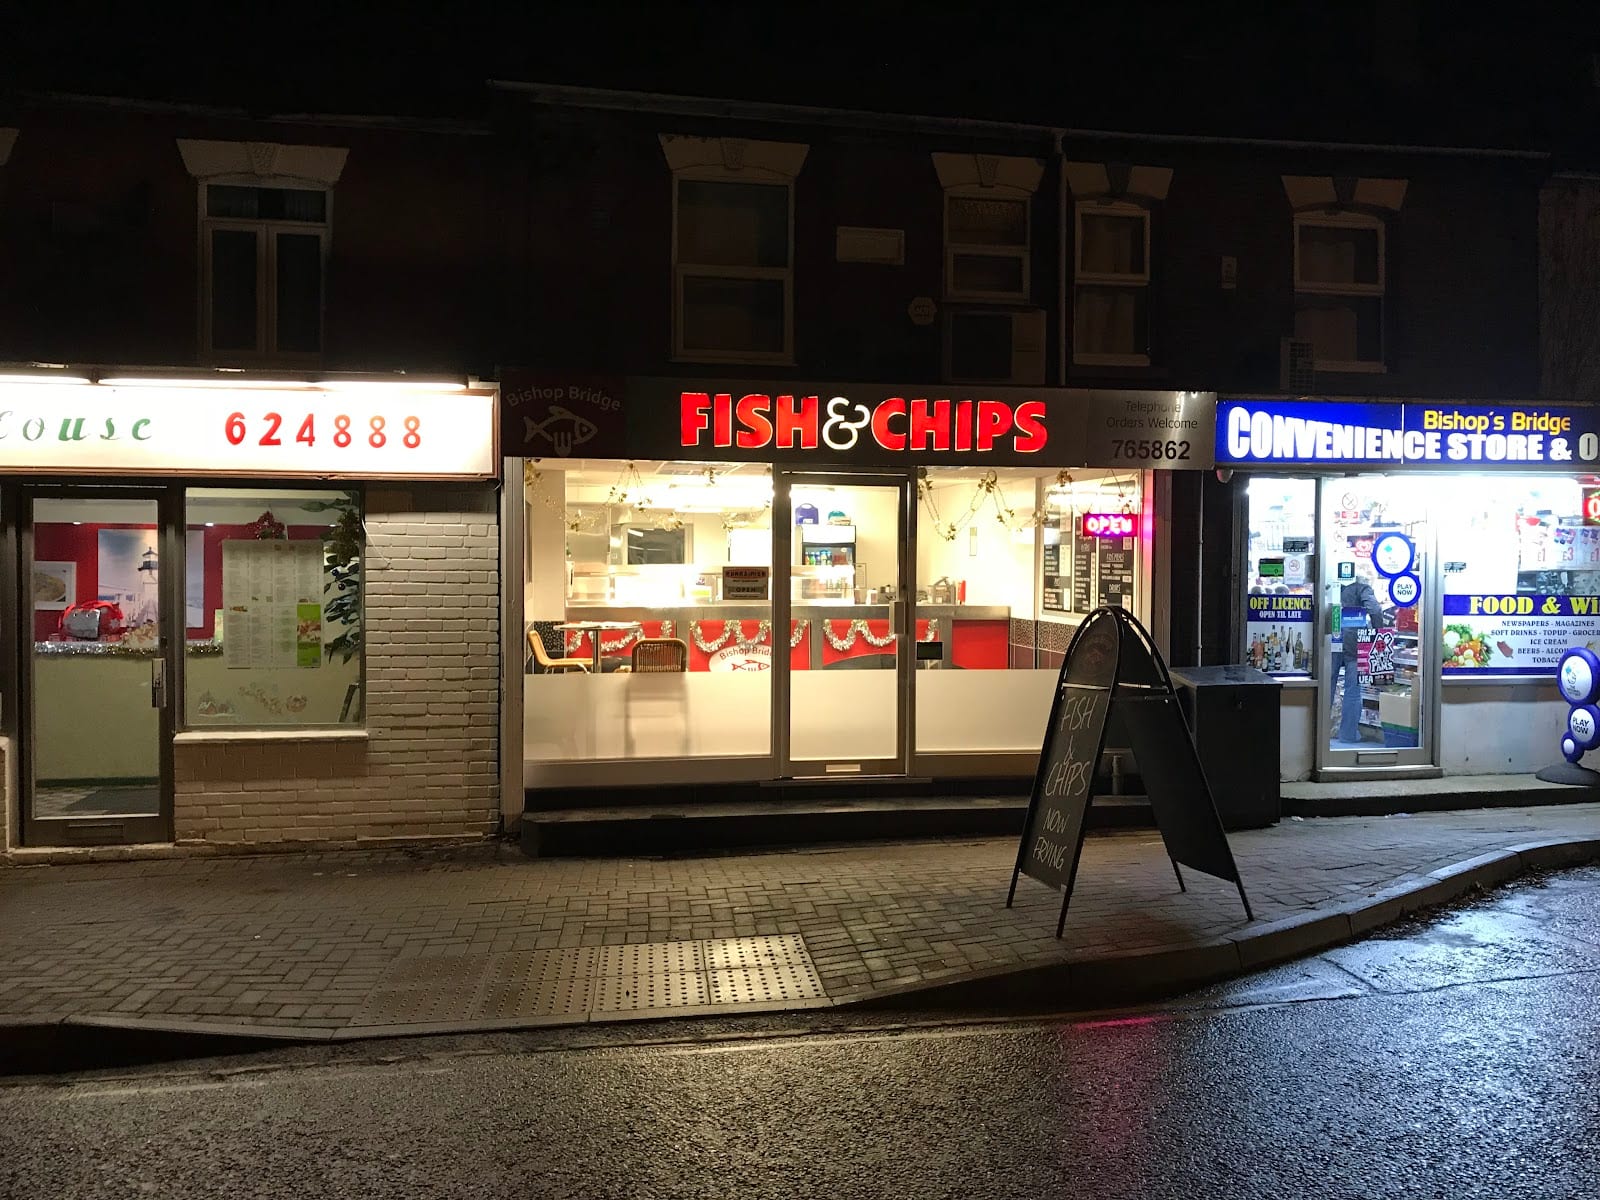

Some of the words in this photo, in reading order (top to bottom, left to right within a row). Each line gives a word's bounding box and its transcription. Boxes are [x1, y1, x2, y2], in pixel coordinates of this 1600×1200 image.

[504, 386, 563, 408] Bishop
[568, 386, 623, 411] Bridge
[1125, 400, 1182, 415] Telephone
[225, 411, 422, 449] 624888
[680, 392, 819, 449] FISH
[822, 396, 871, 450] &
[871, 398, 1048, 453] CHIPS
[1106, 416, 1145, 429] Orders
[1147, 416, 1198, 429] Welcome
[1423, 410, 1505, 434] Bishop's
[1511, 412, 1571, 435] Bridge
[1228, 406, 1441, 460] CONVENIENCE
[1447, 432, 1543, 461] STORE
[1549, 437, 1573, 461] &
[1579, 432, 1599, 461] O
[1111, 439, 1191, 461] 765862
[1087, 516, 1133, 533] OPEN
[1250, 597, 1270, 611] OFF
[1272, 597, 1312, 611] LICENCE
[1469, 596, 1534, 615] FOOD
[1541, 596, 1561, 614] &
[1569, 597, 1600, 614] Wi
[1259, 610, 1275, 619] OPEN
[1276, 610, 1286, 619] TIL
[1287, 610, 1302, 619] LATE
[1357, 628, 1367, 636] FRI
[1357, 635, 1371, 643] JAN
[719, 647, 750, 660] Bishop
[751, 646, 772, 657] Brid
[1358, 675, 1374, 684] UEA
[1060, 695, 1099, 733] FISH
[1572, 716, 1590, 728] PLAY
[1572, 724, 1589, 735] NOW
[1045, 760, 1091, 797] CHIPS
[1043, 808, 1069, 834] NOW
[1032, 836, 1066, 872] FRYING
